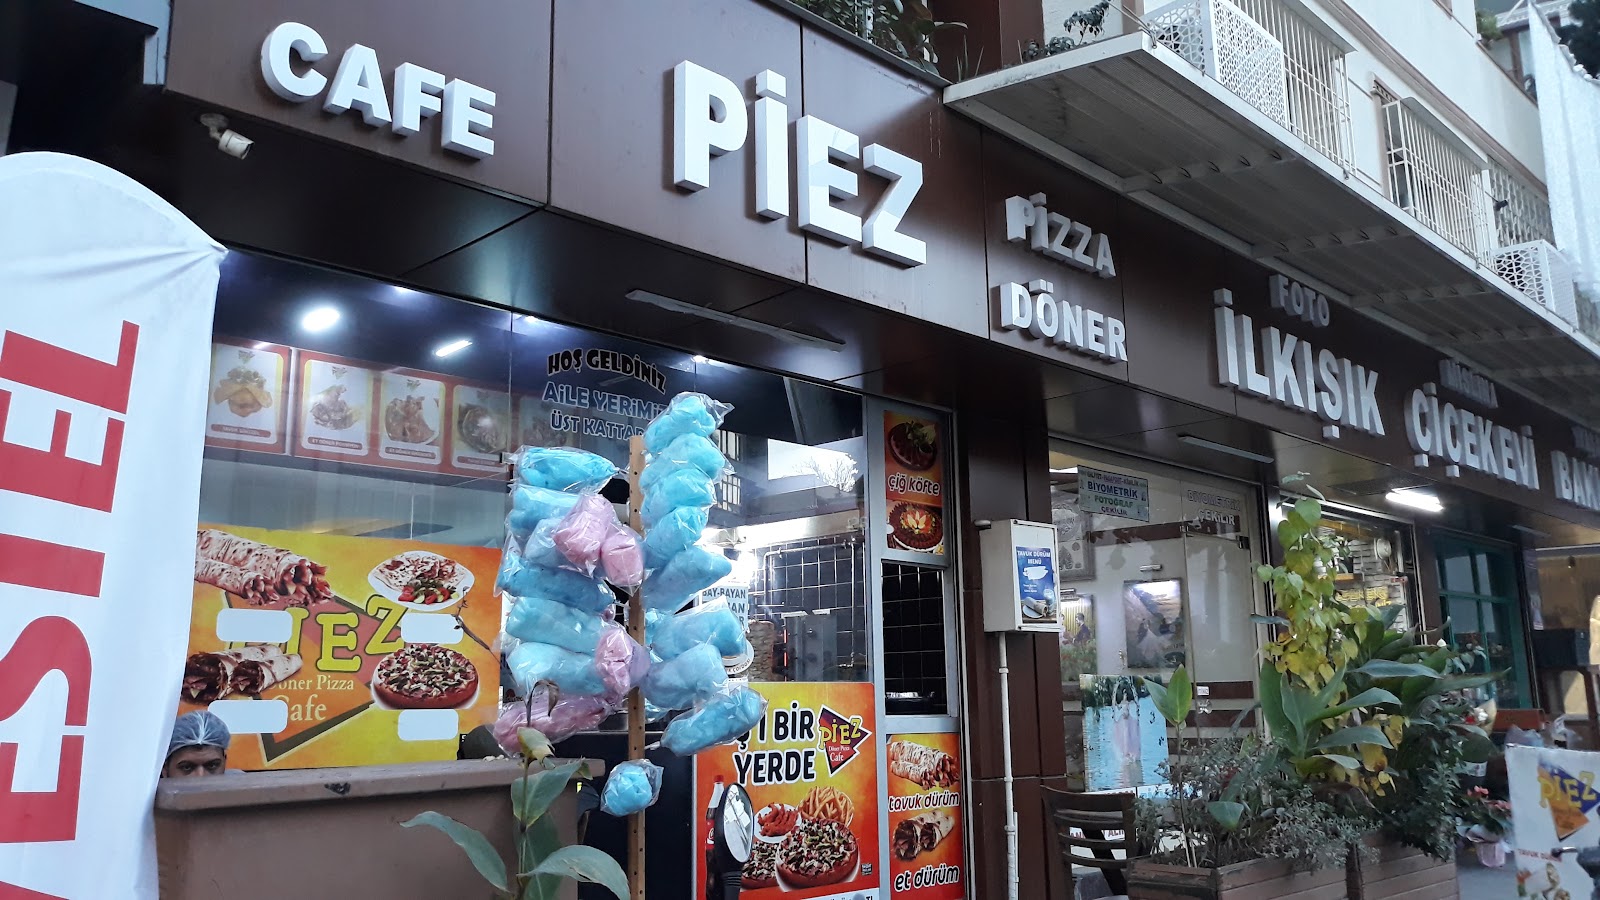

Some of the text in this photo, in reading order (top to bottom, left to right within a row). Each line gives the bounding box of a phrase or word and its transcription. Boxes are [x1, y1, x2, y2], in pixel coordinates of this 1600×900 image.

[261, 22, 496, 159] CAFE
[673, 60, 926, 267] PİEZ
[1005, 191, 1117, 279] PİZZA
[1269, 274, 1330, 328] FOTO
[1001, 279, 1127, 362] DÖNER
[547, 348, 667, 394] HOŞ GELDİNİZ
[1213, 288, 1385, 439] İLKIŞIK
[551, 410, 580, 433] ÜST
[1405, 382, 1539, 490] ÇİÇEKEVİ
[888, 473, 941, 496] çiğ köfte
[1094, 495, 1133, 509] FOTOĞRAF
[317, 674, 354, 690] Pizza
[774, 702, 814, 741] BİR
[819, 718, 862, 750] PİEZ
[734, 751, 815, 786] YERDE
[830, 752, 844, 762] Cafe
[888, 791, 960, 811] tavuk dürüm
[894, 864, 960, 892] et dürüm
